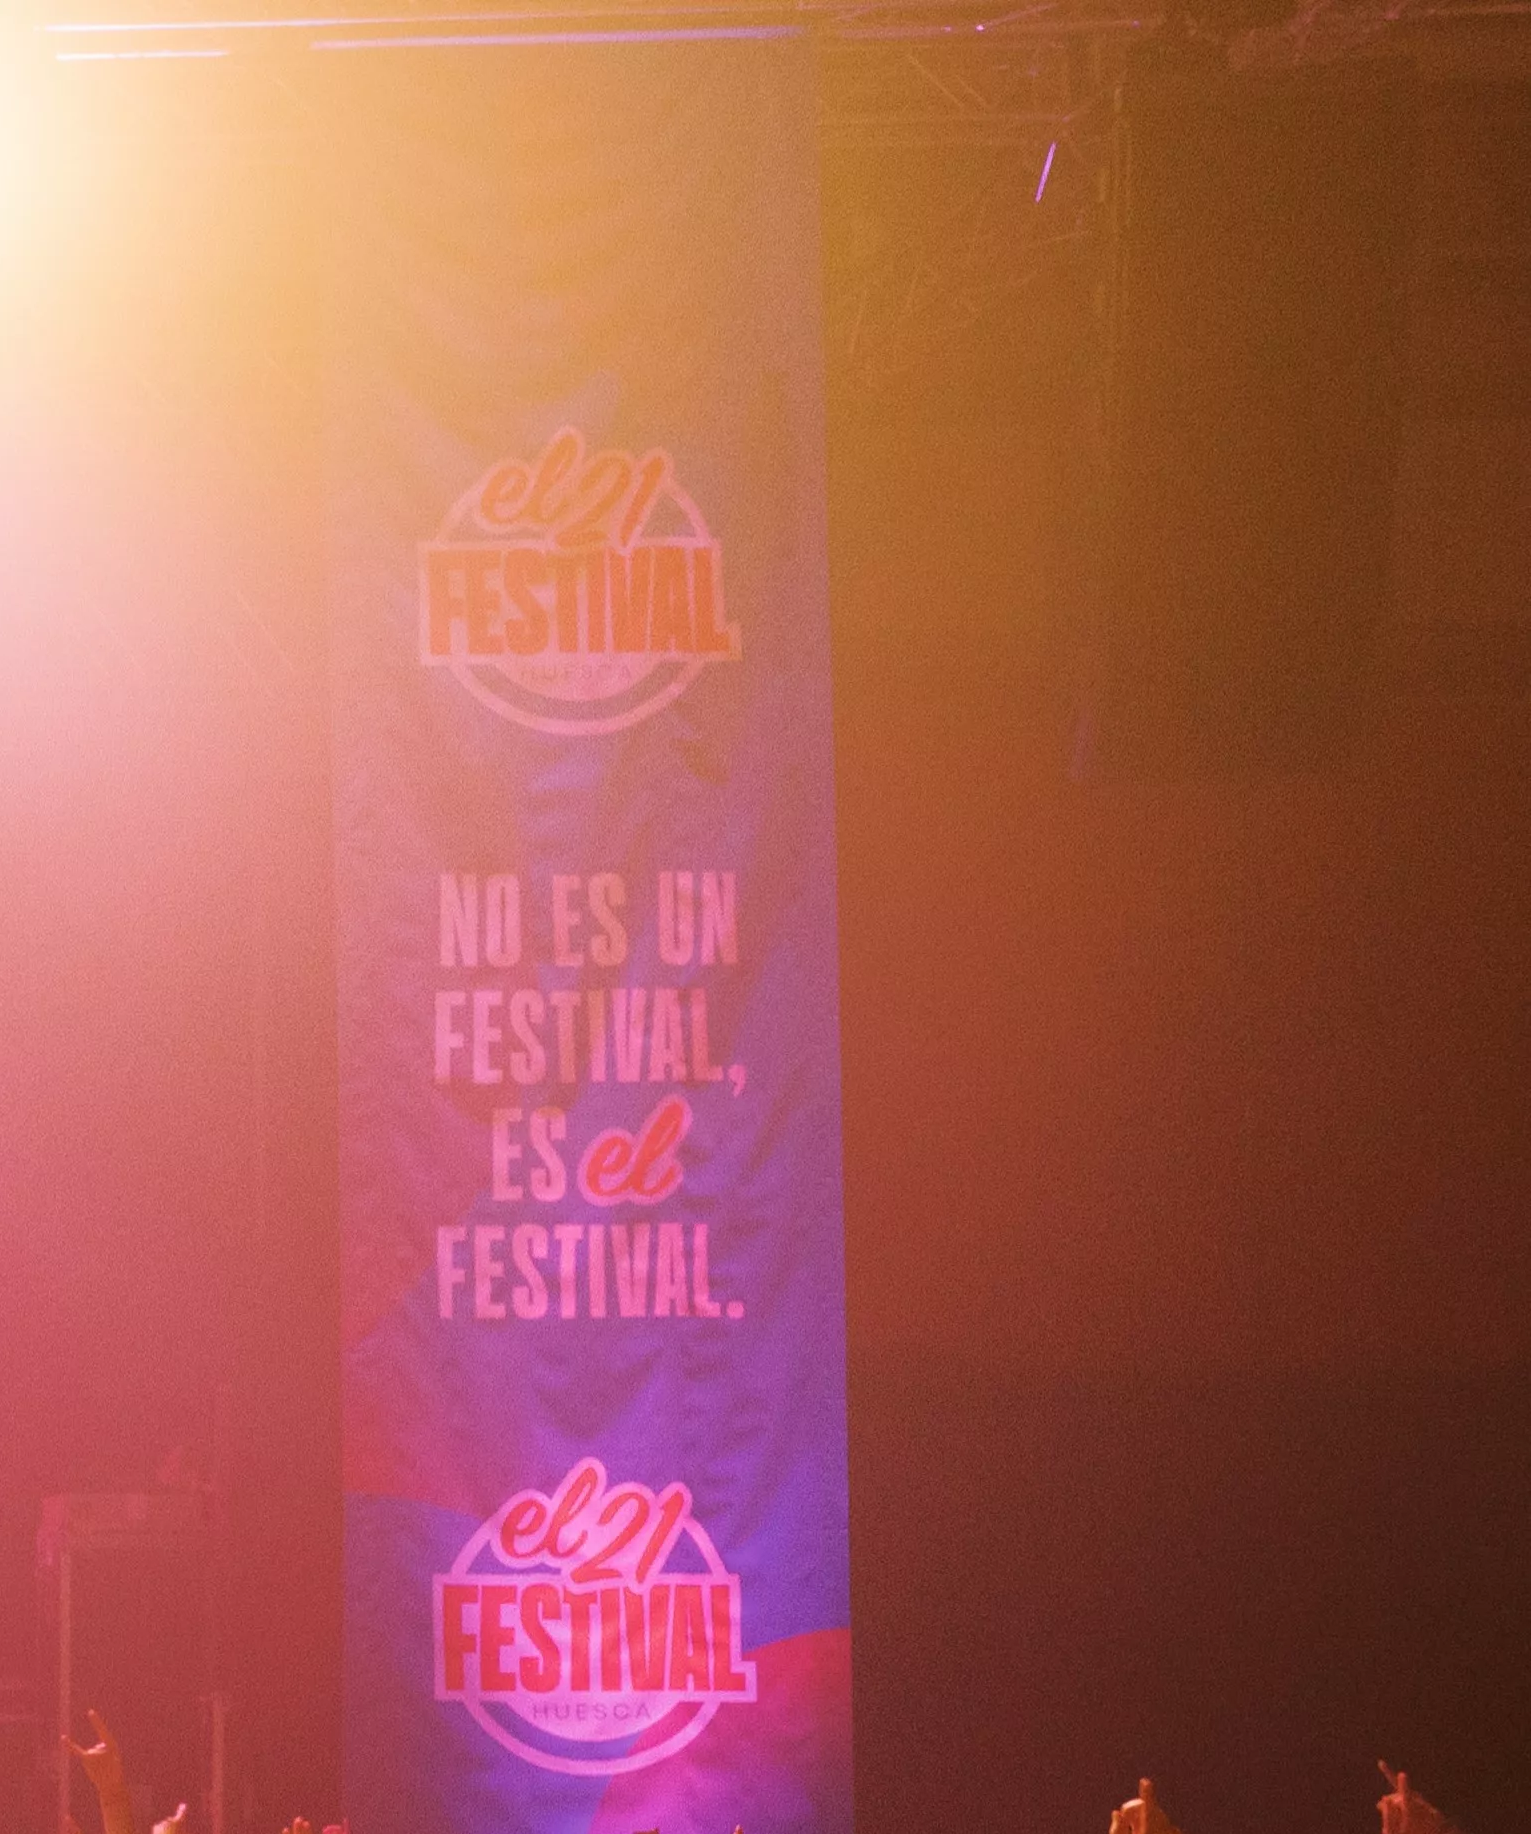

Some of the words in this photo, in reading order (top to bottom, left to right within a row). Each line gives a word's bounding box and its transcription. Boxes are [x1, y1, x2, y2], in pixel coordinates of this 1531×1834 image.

[426, 545, 739, 656] FESTIVAL
[438, 873, 521, 970] NO
[552, 873, 627, 970] ES
[657, 871, 739, 968] UN
[434, 990, 748, 1096] FESTIVAL,
[492, 1107, 566, 1203] ES
[582, 1098, 687, 1203] el
[437, 1225, 745, 1322] FESTIVAL.
[441, 1582, 748, 1693] FESTIVAL
[531, 1702, 653, 1722] HUESCA
